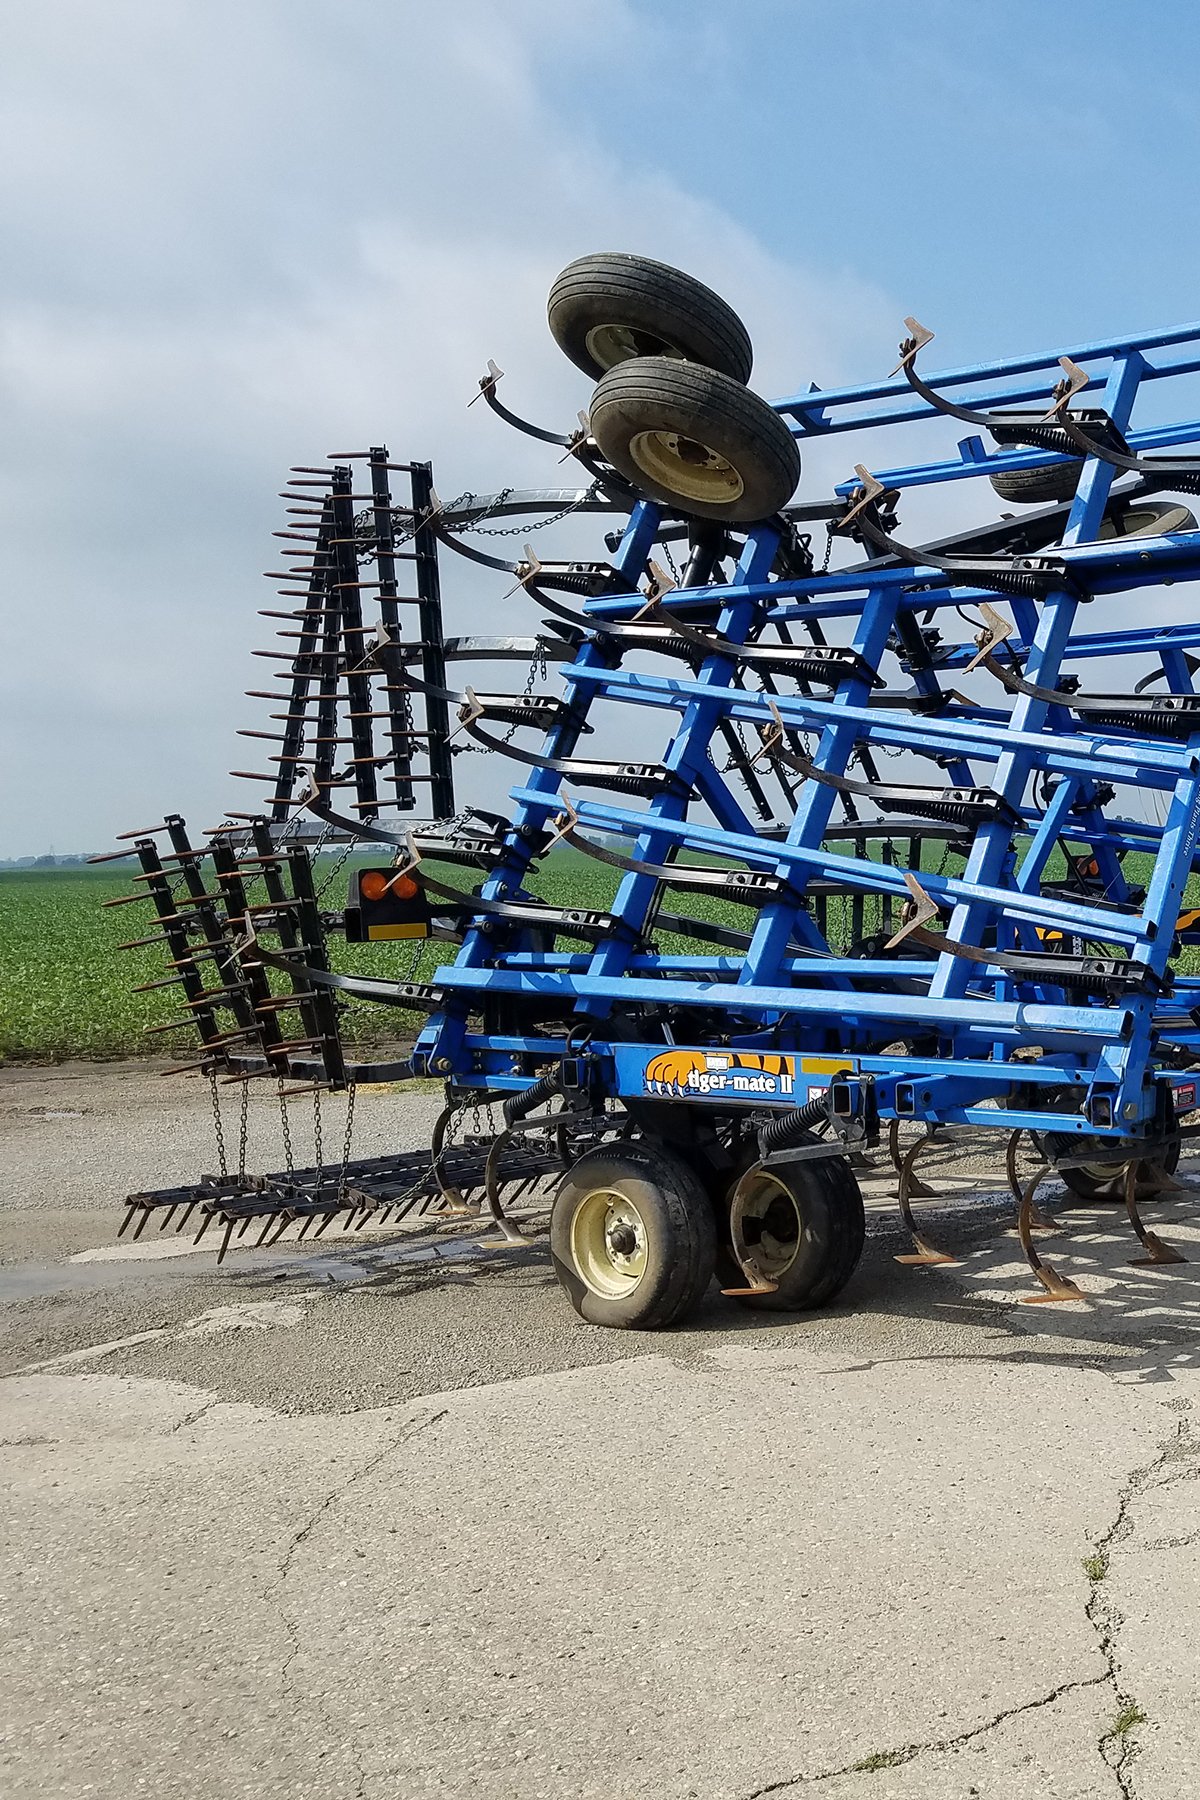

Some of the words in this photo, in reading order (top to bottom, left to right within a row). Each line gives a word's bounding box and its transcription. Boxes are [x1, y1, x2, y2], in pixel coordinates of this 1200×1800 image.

[1190, 805, 1200, 829] Plants
[1183, 831, 1195, 856] Thrive
[688, 1069, 776, 1093] tiger-mate
[781, 1074, 793, 1093] II
